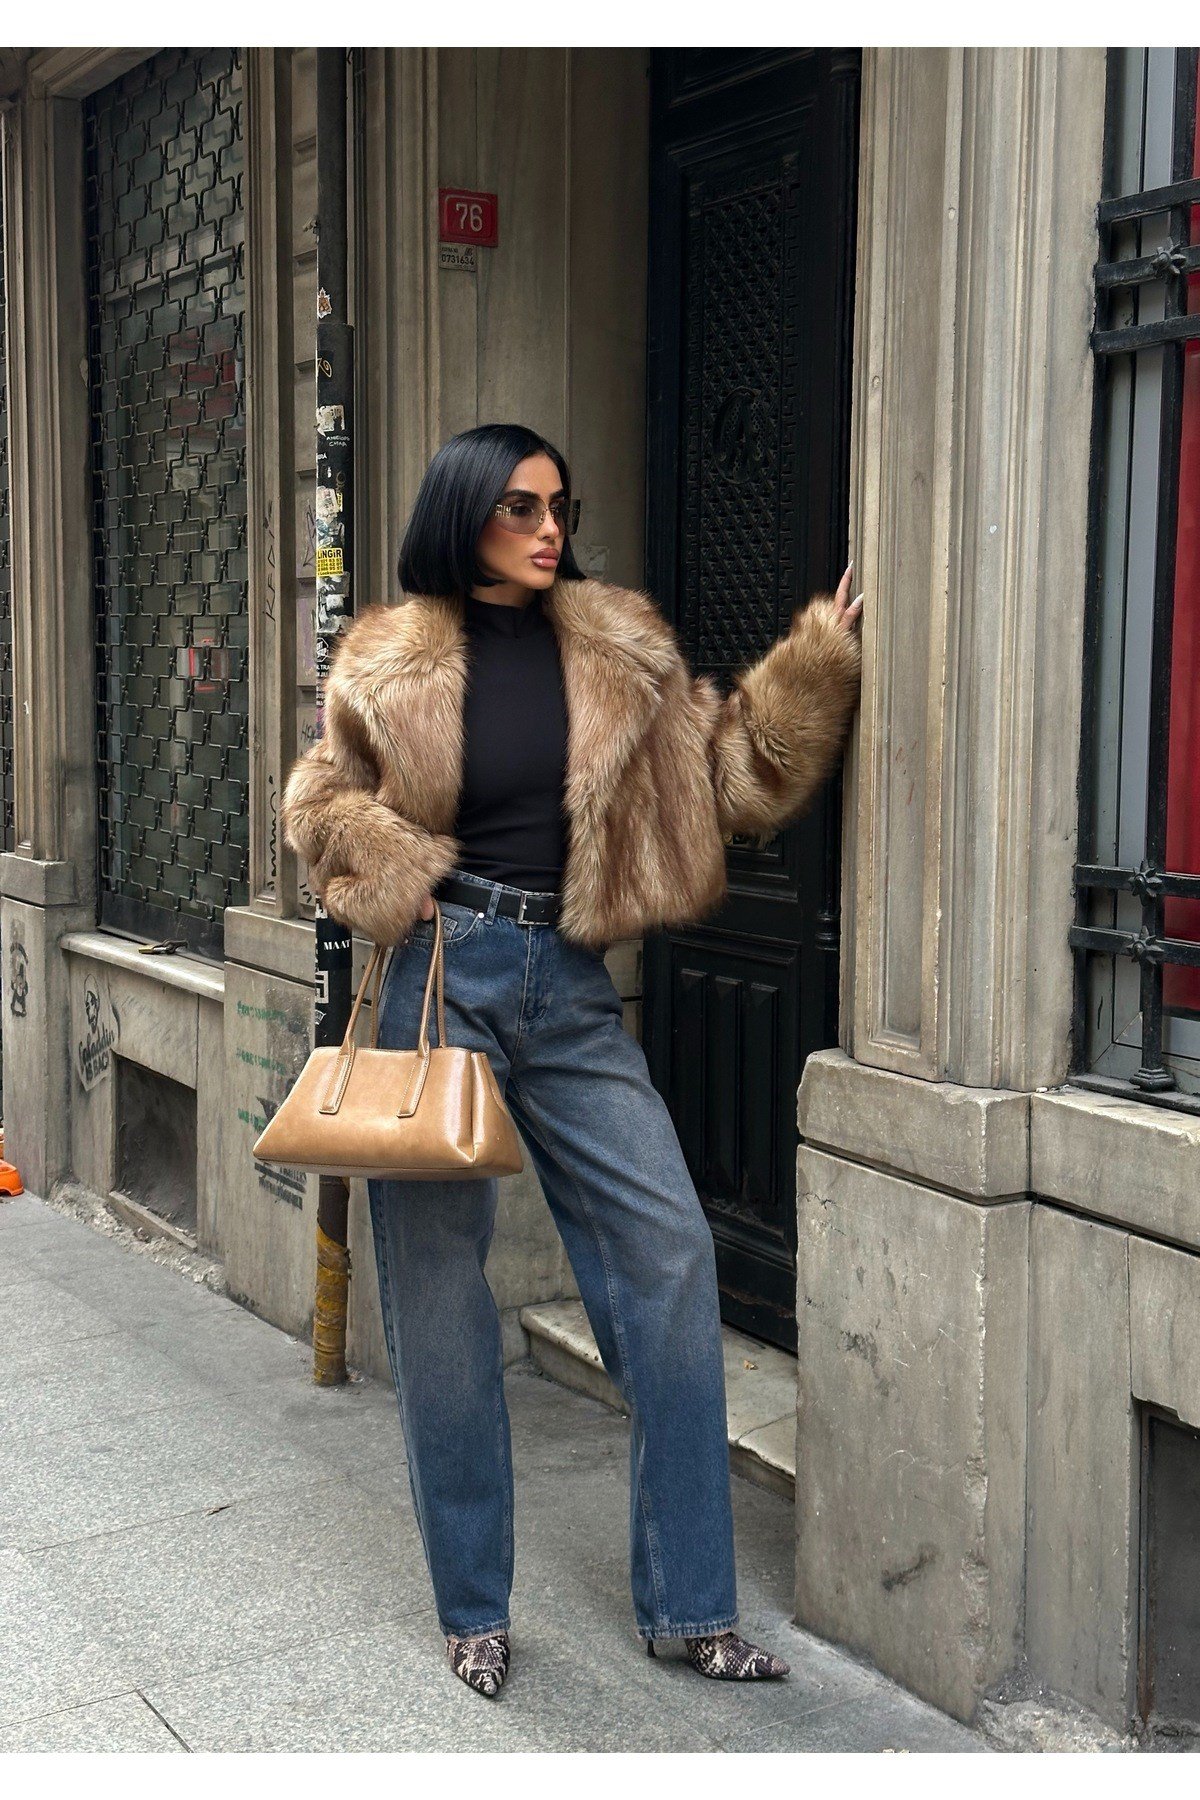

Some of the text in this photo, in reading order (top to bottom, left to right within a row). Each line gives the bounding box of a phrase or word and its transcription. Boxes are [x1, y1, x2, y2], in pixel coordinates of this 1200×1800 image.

[456, 203, 482, 232] 76
[441, 254, 474, 265] 0731634
[324, 940, 350, 950] MAAT
